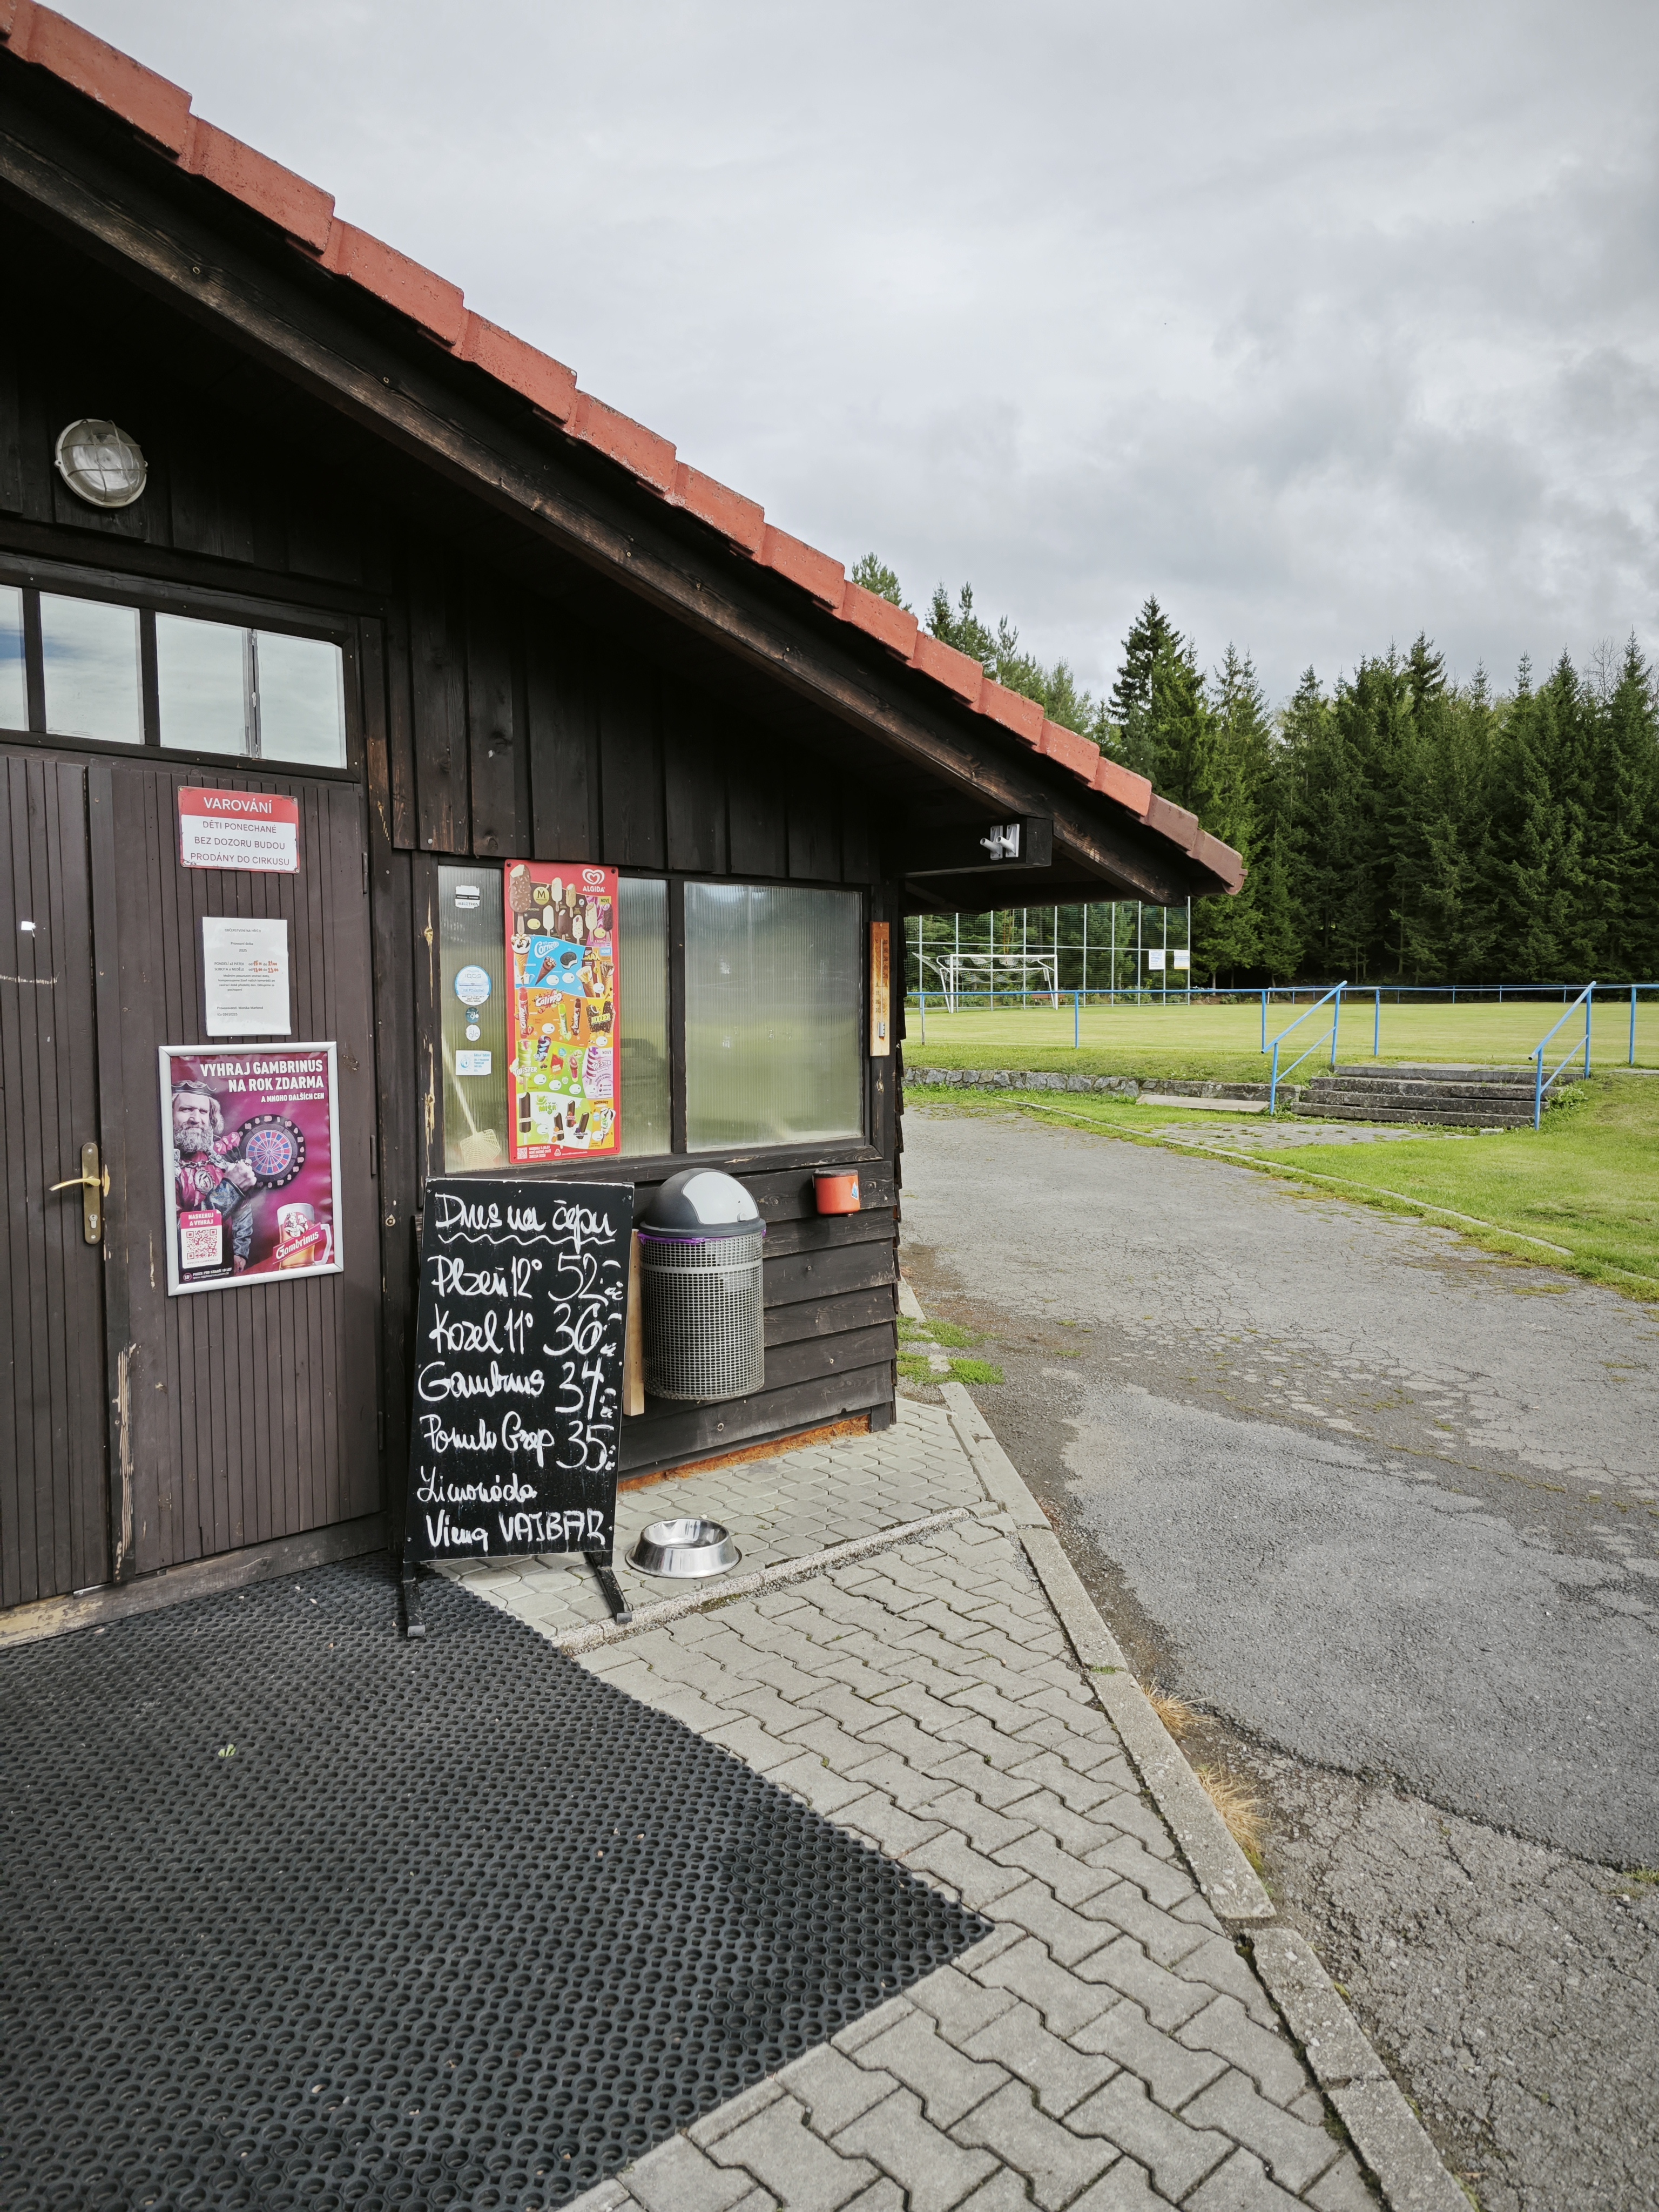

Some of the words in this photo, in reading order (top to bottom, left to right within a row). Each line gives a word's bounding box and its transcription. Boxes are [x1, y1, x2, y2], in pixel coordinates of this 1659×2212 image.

[204, 797, 272, 814] VAROVÁNÍ
[203, 820, 222, 829] DĚTI
[225, 823, 276, 833] PONECHANÉ
[194, 837, 211, 845] BEZ
[214, 838, 252, 847] DOZORU
[254, 841, 285, 849] BUDOU
[191, 852, 234, 862] PRODÁNY
[252, 857, 289, 865] CIRKUSU
[534, 941, 559, 958] Cornetto
[535, 993, 562, 1007] Calippo
[468, 1030, 479, 1039] glo
[200, 1062, 250, 1077] VYHRAJ
[253, 1060, 323, 1075] GAMBRINUS
[228, 1079, 246, 1092] NA
[248, 1078, 273, 1091] ROK
[275, 1075, 324, 1090] ZDARMA
[288, 1092, 313, 1101] DALŠÍCH
[435, 1192, 503, 1230] Dnes
[507, 1205, 547, 1231] na
[552, 1199, 618, 1255] čepu
[276, 1231, 319, 1259] Gambrinus
[427, 1255, 509, 1297] Plzeň
[429, 1303, 504, 1354] Kozel
[501, 1411, 555, 1468] Grep
[417, 1465, 538, 1503] Limonáda
